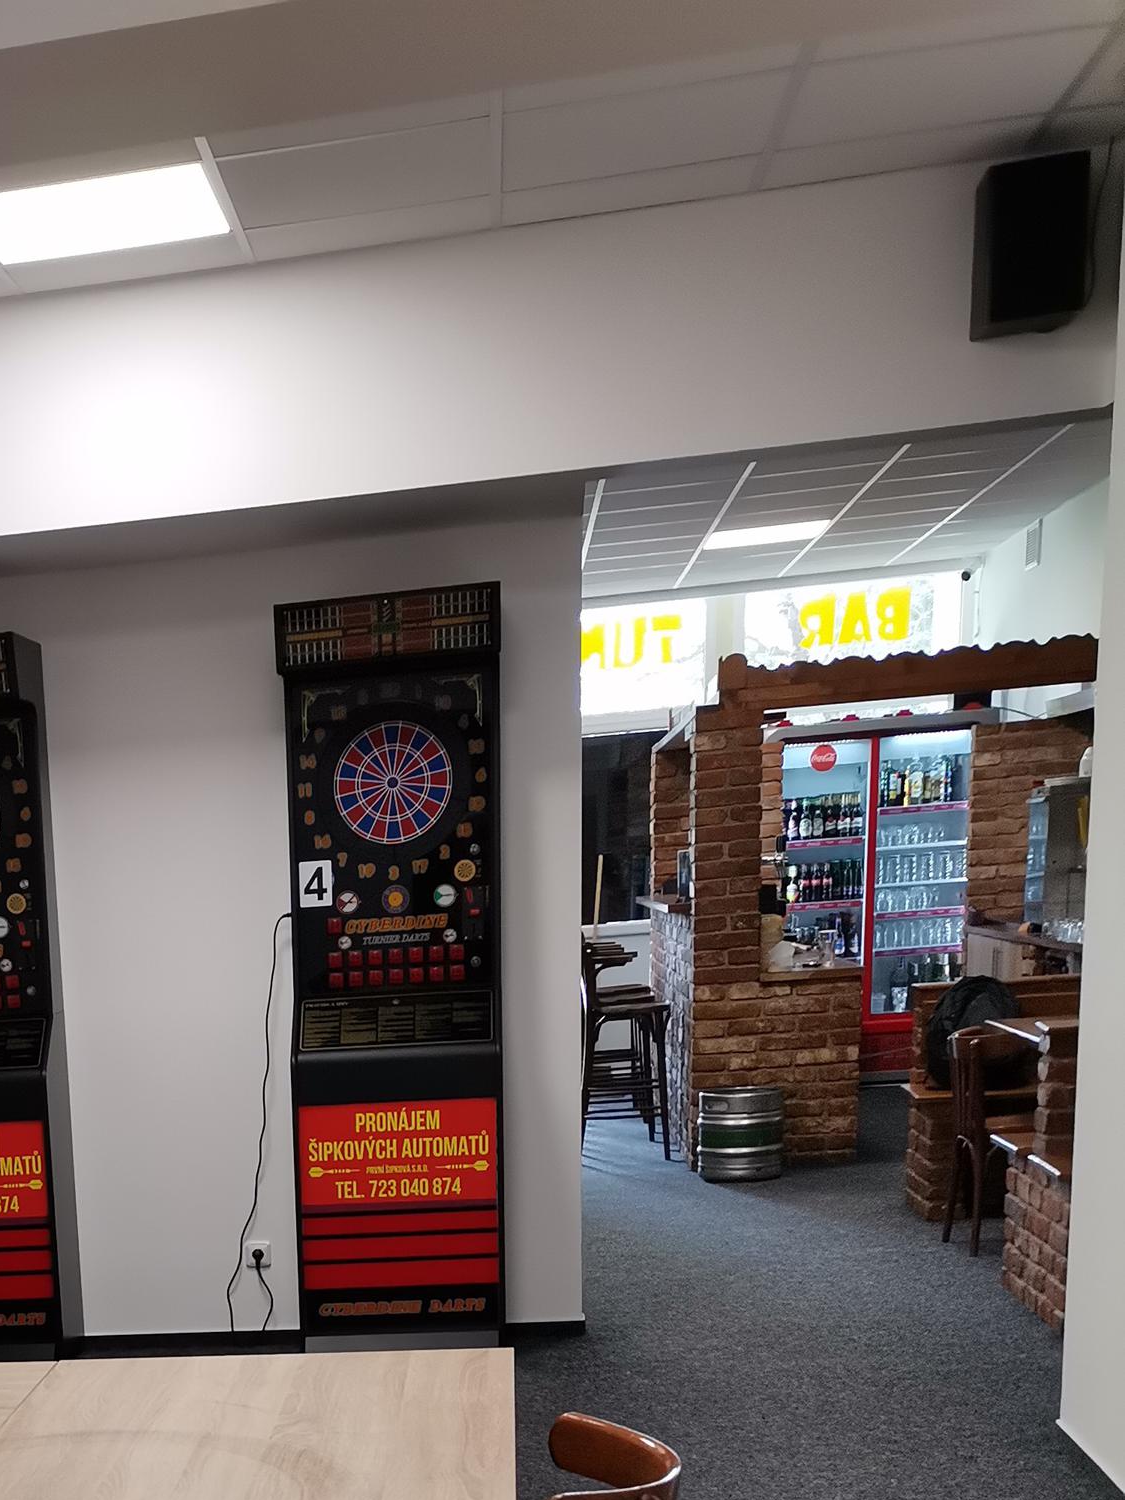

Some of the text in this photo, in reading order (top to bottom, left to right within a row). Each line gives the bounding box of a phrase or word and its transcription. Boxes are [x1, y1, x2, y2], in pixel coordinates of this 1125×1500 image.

[811, 752, 836, 763] Coca-Cola
[304, 866, 327, 901] 4
[345, 913, 449, 935] CYBERDINE
[401, 932, 431, 943] DARTS
[355, 1107, 440, 1133] PRONÁJEM
[308, 1130, 489, 1162] ŠIPKOVÝCH AUTOMATŮ
[335, 1176, 461, 1199] TEL. 723 040 874
[428, 1297, 486, 1313] DARTS
